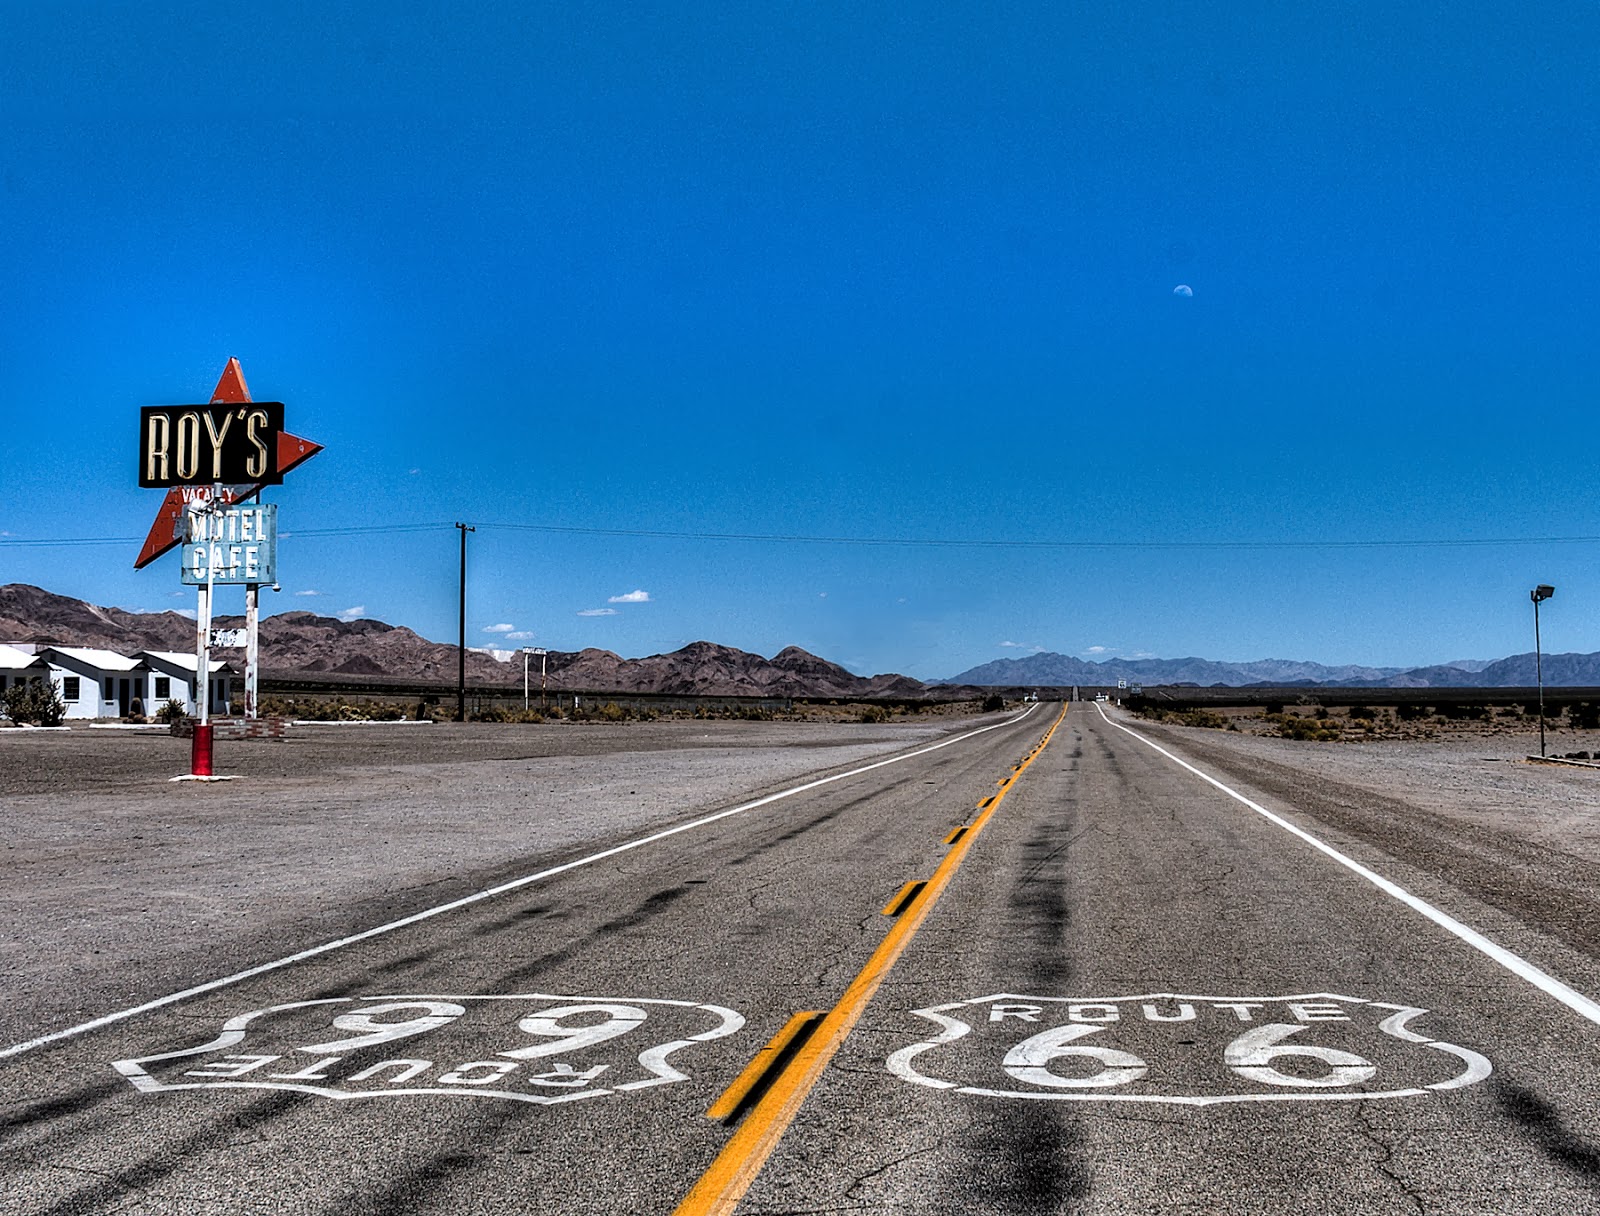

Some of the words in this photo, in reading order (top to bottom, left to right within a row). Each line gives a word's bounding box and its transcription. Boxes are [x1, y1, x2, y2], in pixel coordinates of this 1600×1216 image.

[147, 406, 268, 480] ROY'S
[182, 487, 234, 502] VACAY
[188, 509, 266, 542] MOTEL
[193, 546, 258, 579] CAFE
[989, 1002, 1351, 1022] ROUTE
[297, 1001, 648, 1059] 66
[184, 1054, 610, 1087] ROUTE
[1002, 1023, 1377, 1087] 66
